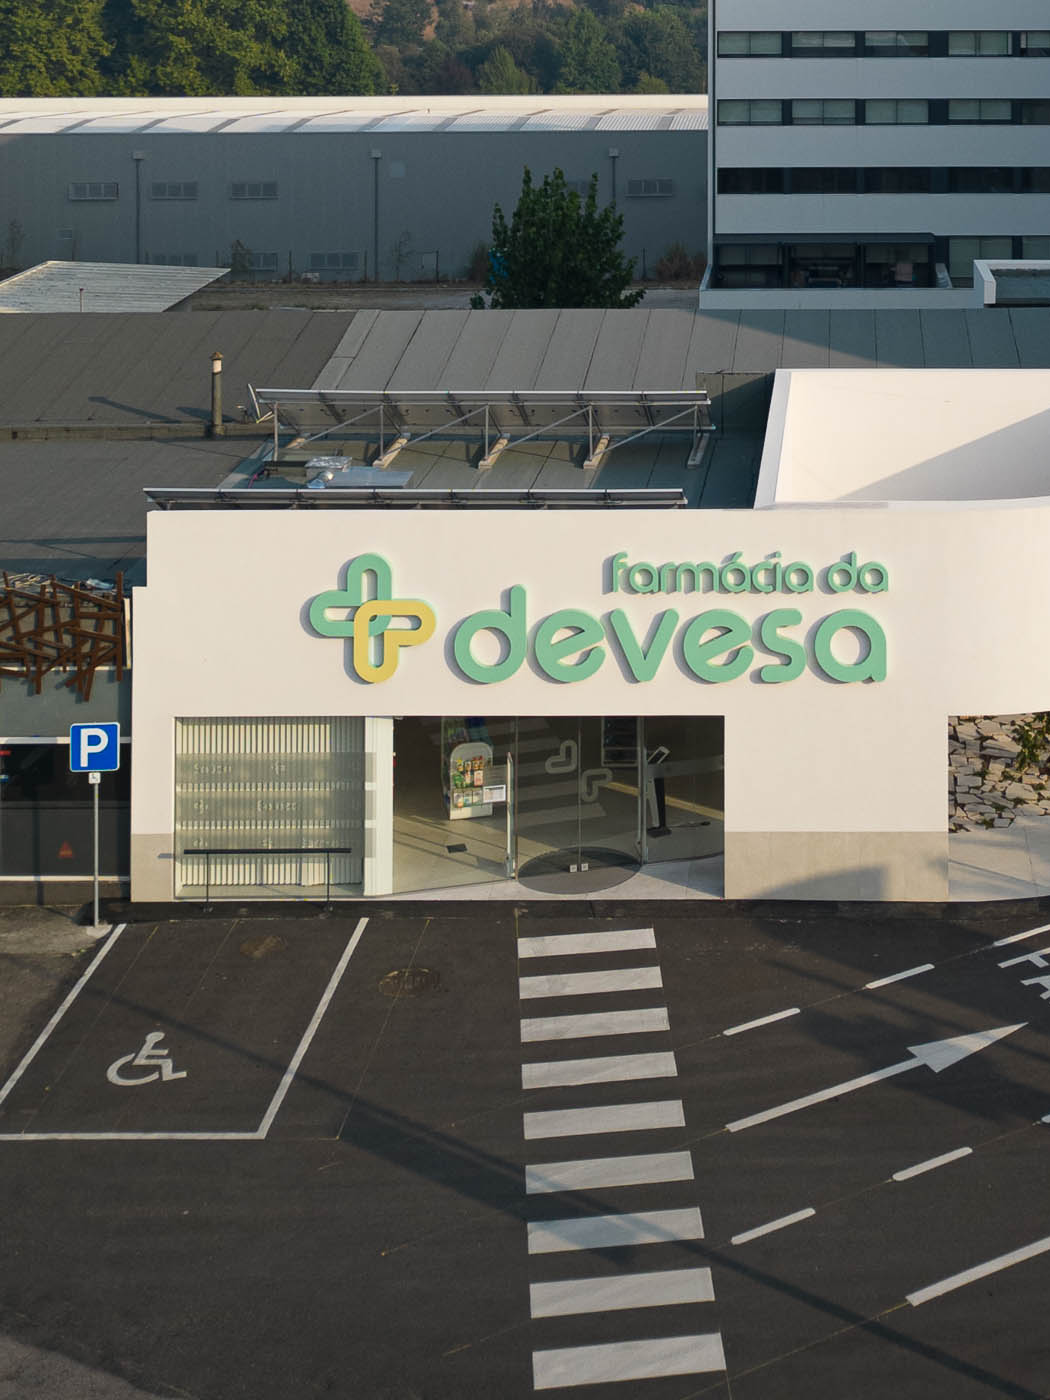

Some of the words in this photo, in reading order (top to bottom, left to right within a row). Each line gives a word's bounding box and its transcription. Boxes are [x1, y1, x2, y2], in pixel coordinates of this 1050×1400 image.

[611, 551, 814, 593] farmácia
[828, 551, 889, 593] da
[453, 584, 888, 684] devesa
[79, 728, 109, 768] P
